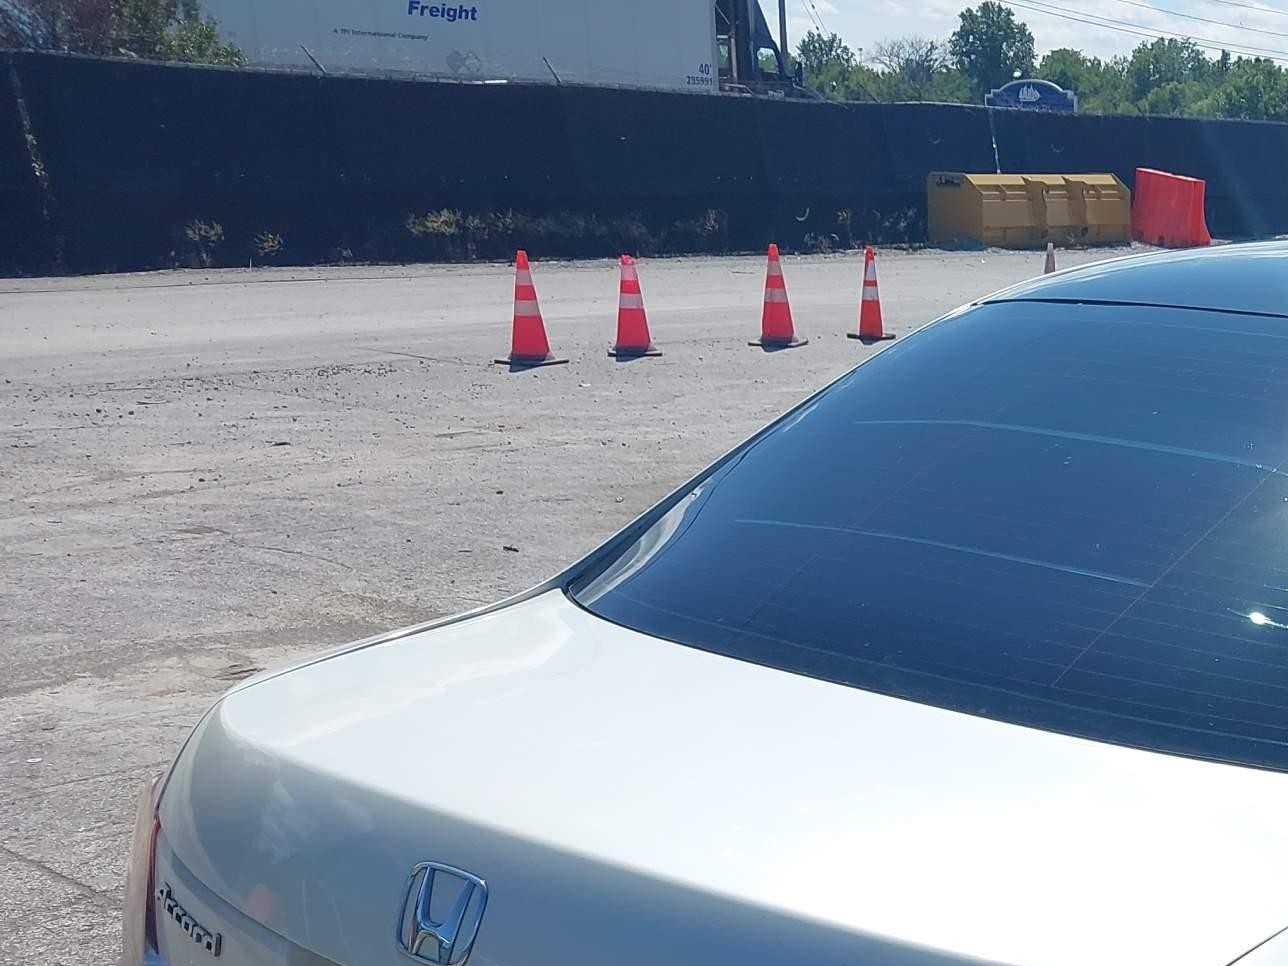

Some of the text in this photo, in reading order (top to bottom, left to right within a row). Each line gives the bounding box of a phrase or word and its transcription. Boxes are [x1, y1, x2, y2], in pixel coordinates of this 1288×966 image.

[408, 0, 478, 22] Freight
[351, 29, 397, 38] International
[398, 32, 428, 41] Company
[157, 881, 223, 958] Accord
